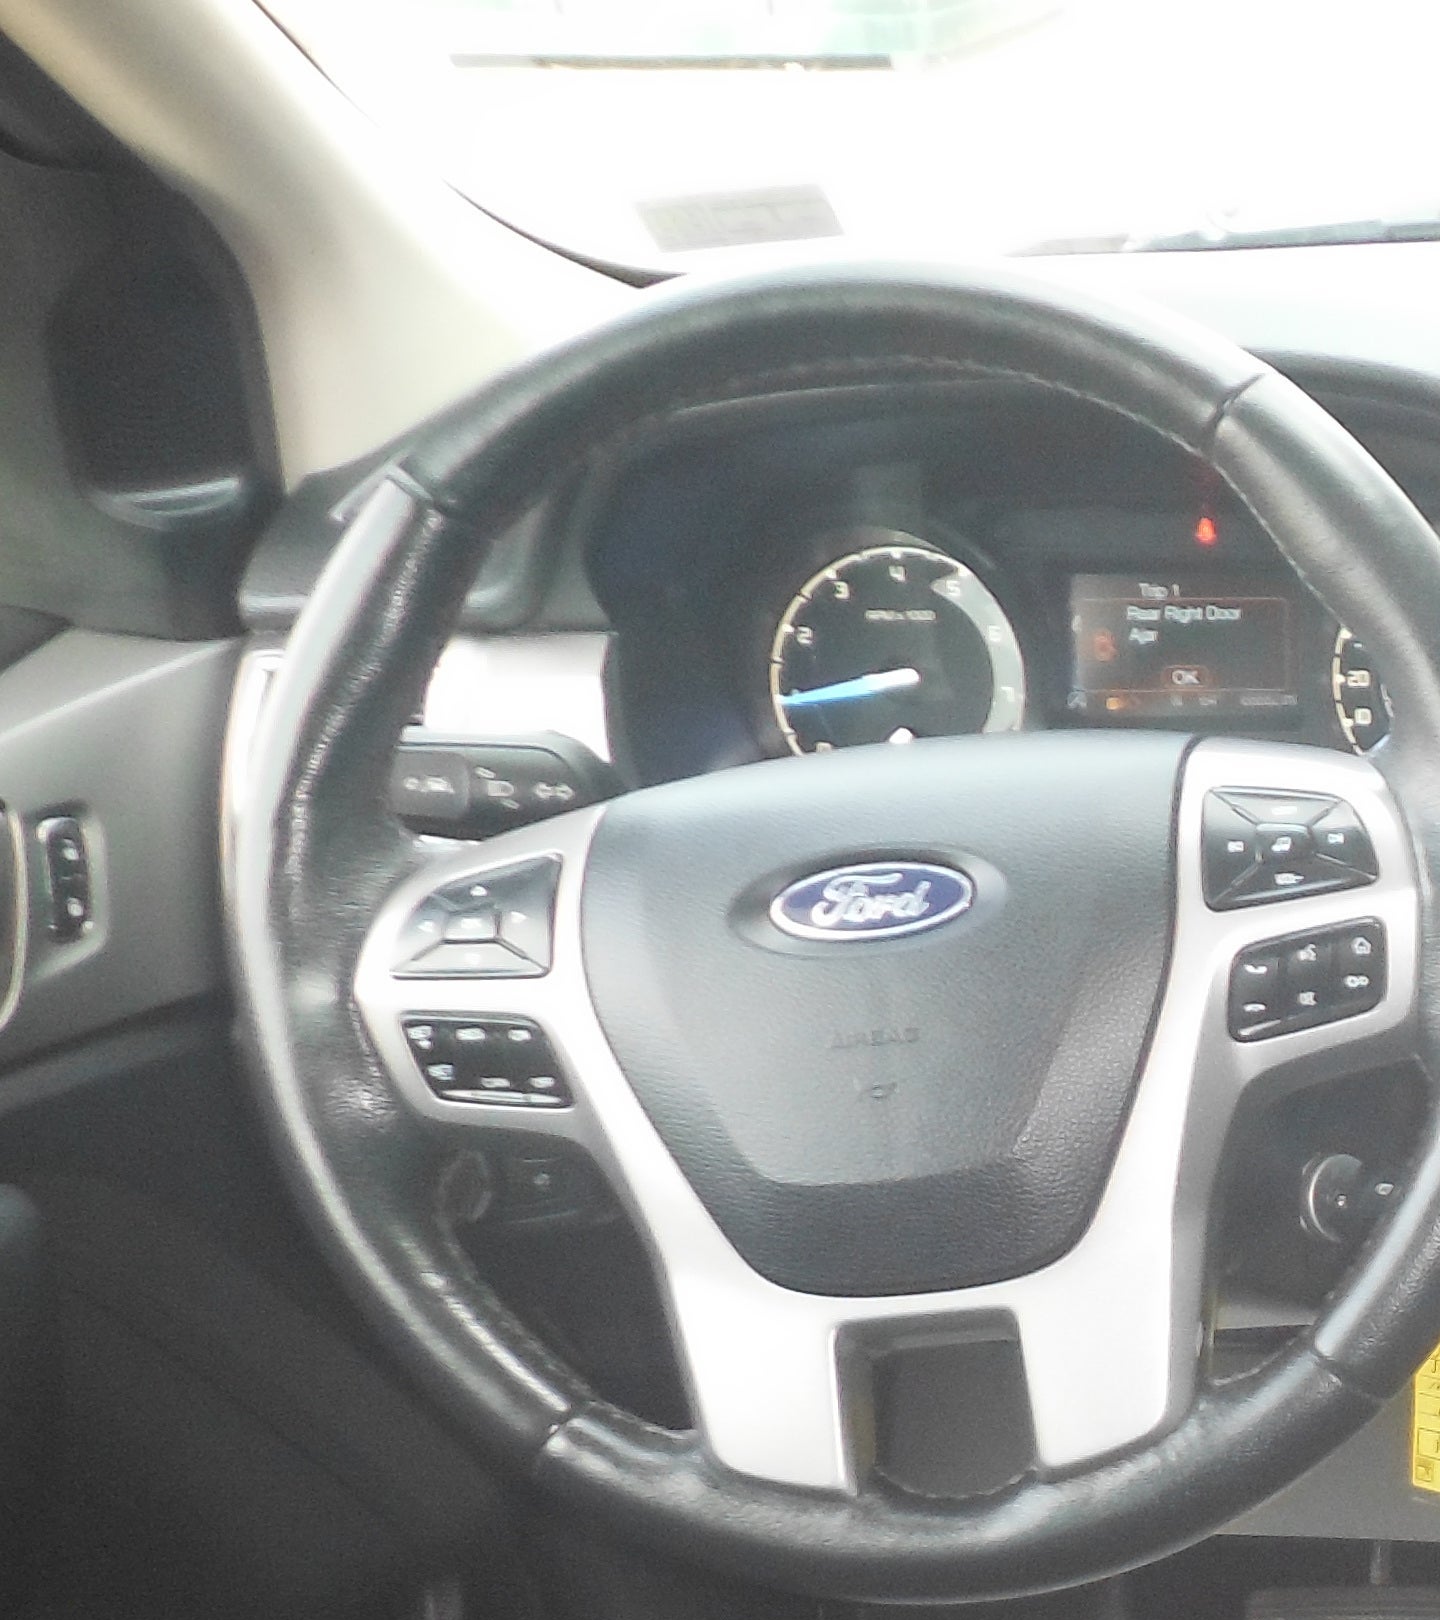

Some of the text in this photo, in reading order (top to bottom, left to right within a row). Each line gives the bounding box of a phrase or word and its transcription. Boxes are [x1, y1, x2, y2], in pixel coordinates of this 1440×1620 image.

[889, 566, 905, 581] 4
[834, 580, 849, 599] 3
[946, 580, 960, 596] 5
[1127, 605, 1242, 623] Rear Right Door
[796, 626, 812, 644] 2
[1172, 669, 1200, 684] OK
[1348, 670, 1370, 686] 20
[811, 873, 932, 926] Ford
